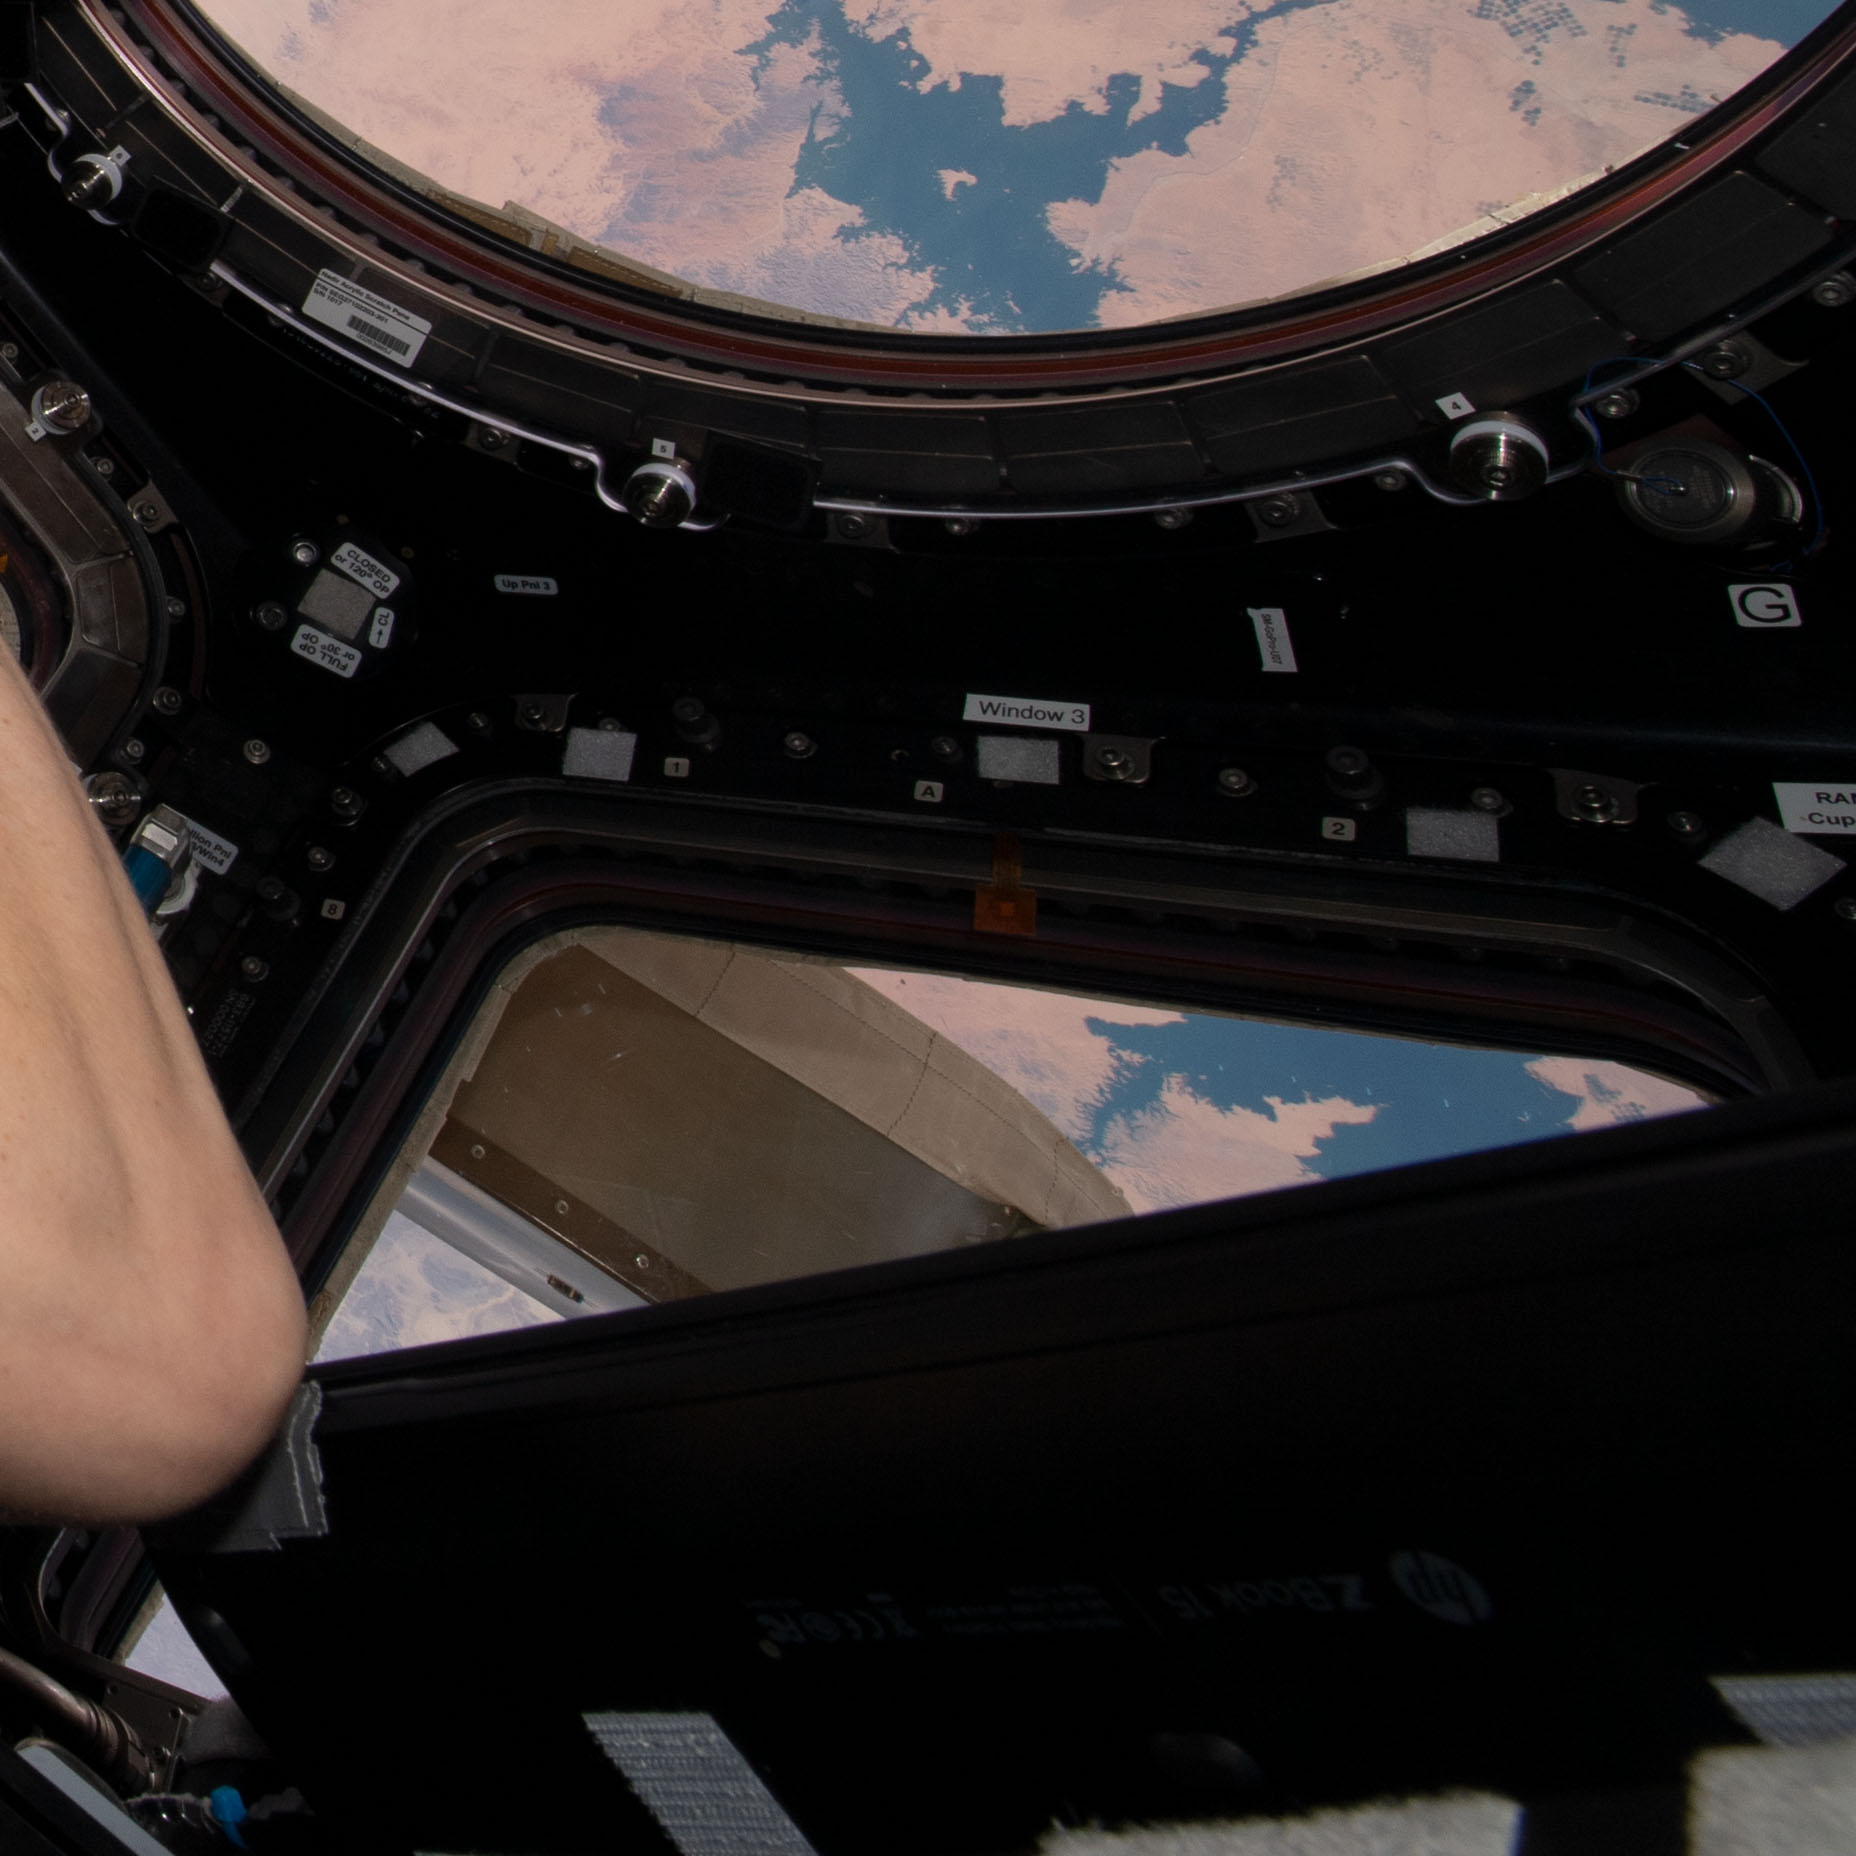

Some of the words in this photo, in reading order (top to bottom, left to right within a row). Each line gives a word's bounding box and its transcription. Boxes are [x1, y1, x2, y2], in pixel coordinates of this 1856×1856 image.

[320, 269, 340, 284] Nadir
[340, 279, 365, 298] Acrylic
[364, 292, 392, 311] Scratch
[391, 306, 411, 320] Pane
[1450, 400, 1461, 411] 4
[659, 444, 666, 453] 5
[333, 552, 347, 565] or
[371, 578, 390, 595] OP
[345, 547, 392, 585] CLOSED
[500, 578, 518, 589] Up
[520, 579, 541, 590] Pnl
[1738, 586, 1791, 623] G
[376, 610, 390, 627] CL
[299, 629, 320, 645] OP
[297, 640, 317, 656] OP
[341, 649, 356, 662] or
[316, 649, 349, 672] FULL
[979, 700, 1064, 722] Window
[1070, 708, 1085, 725] 3
[672, 761, 680, 773] 1
[921, 785, 935, 798] A
[1331, 821, 1345, 835] 2
[212, 843, 232, 859] Pnl
[327, 903, 337, 916] 8
